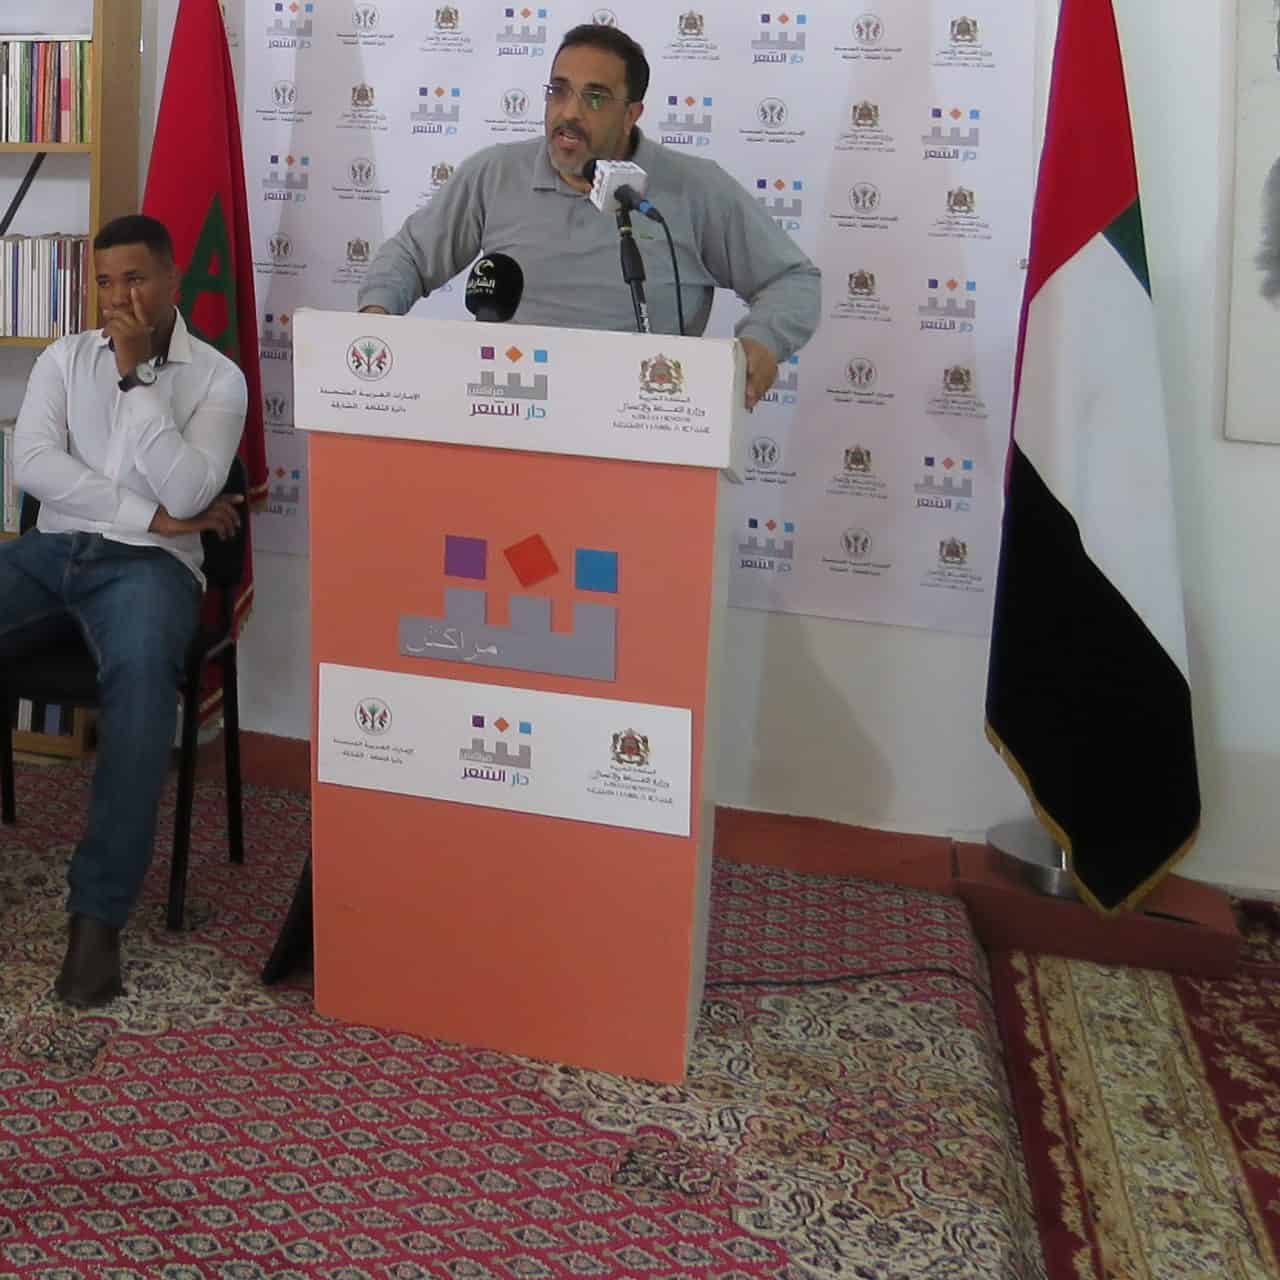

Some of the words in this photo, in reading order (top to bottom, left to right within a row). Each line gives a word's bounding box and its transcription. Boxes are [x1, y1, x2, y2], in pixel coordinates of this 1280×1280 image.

[469, 399, 520, 418] الشعر
[524, 403, 546, 421] دار
[405, 623, 500, 661] مراكش
[461, 765, 506, 783] الشعر
[511, 772, 530, 788] دار
